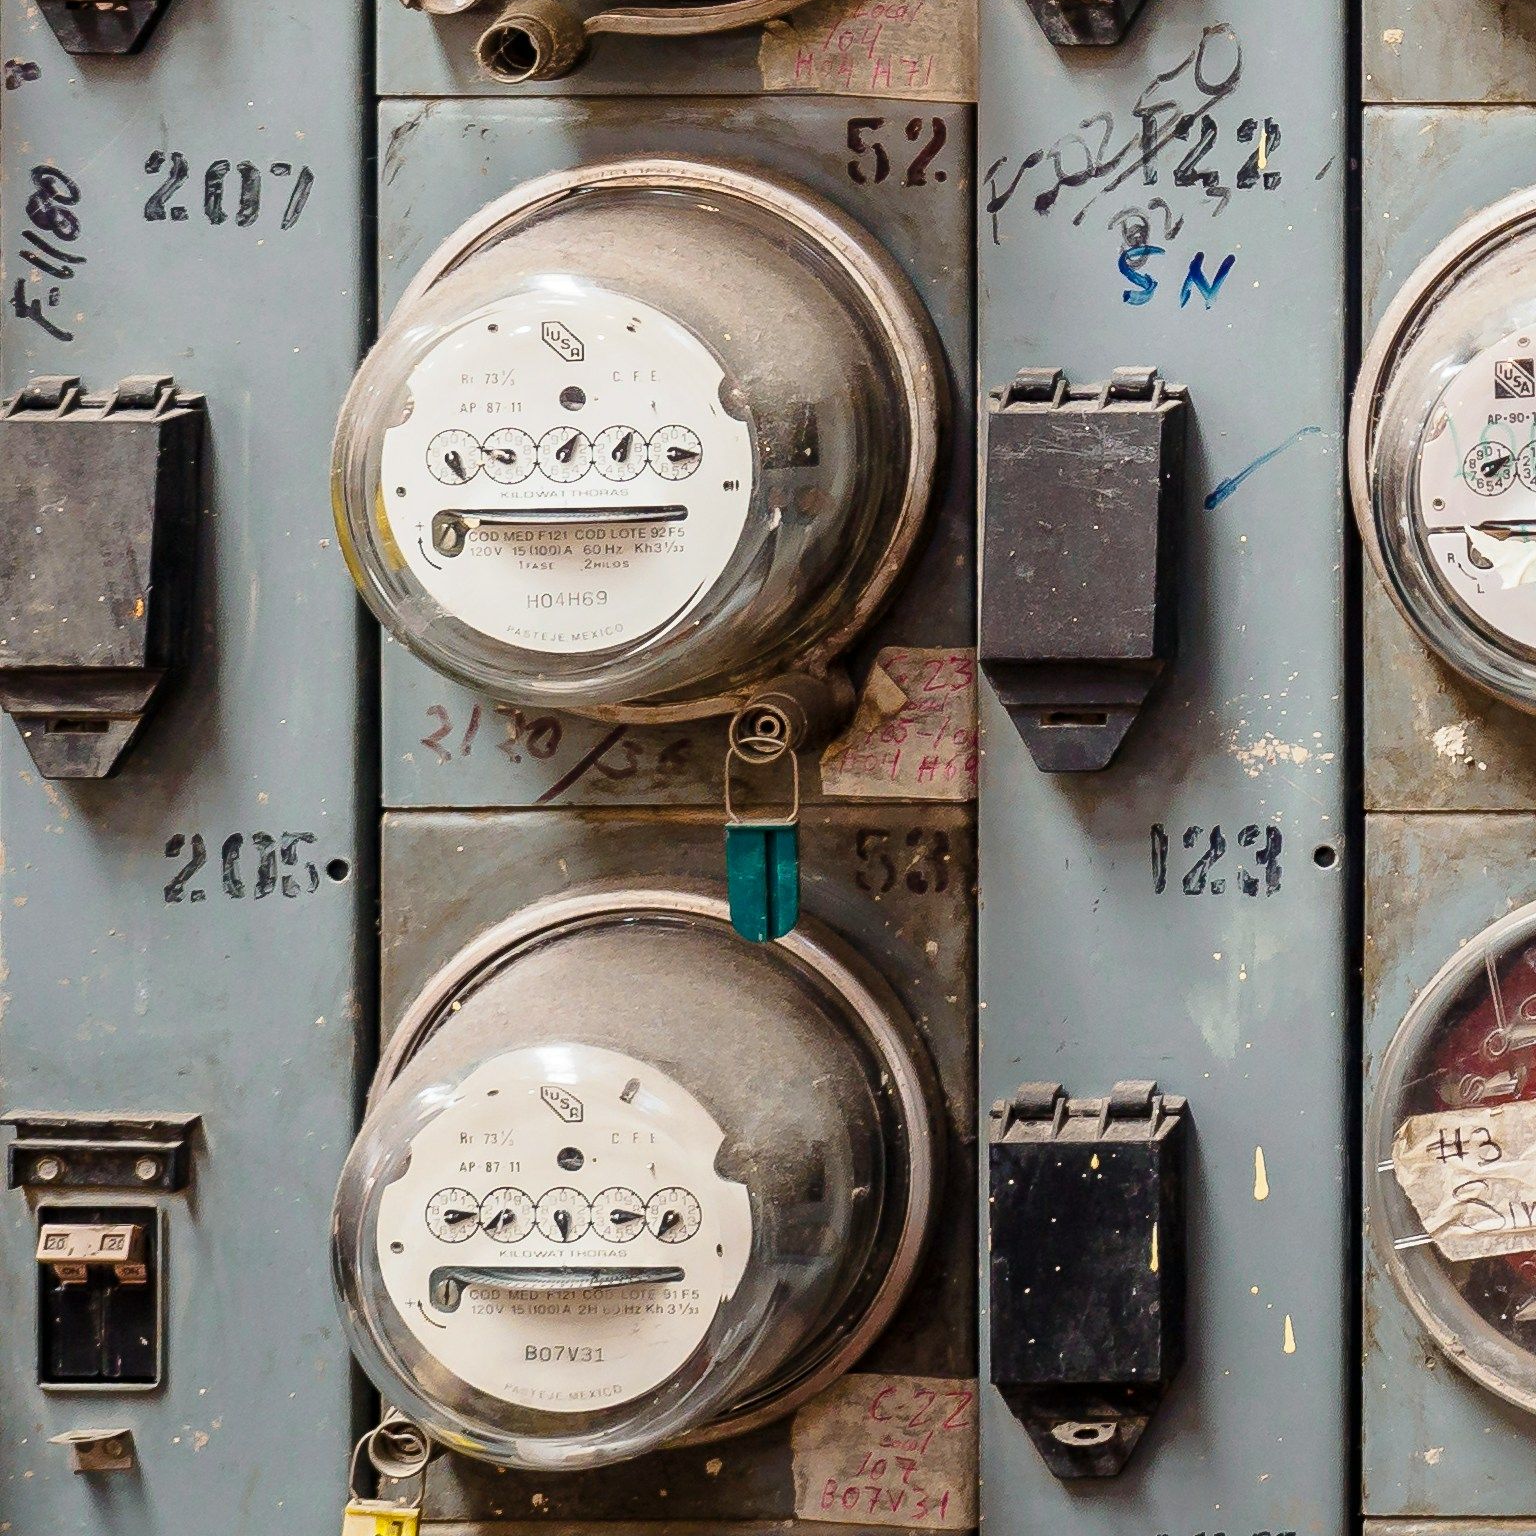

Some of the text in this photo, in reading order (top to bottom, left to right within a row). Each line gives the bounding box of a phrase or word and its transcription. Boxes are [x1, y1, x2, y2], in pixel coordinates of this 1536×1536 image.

[846, 117, 948, 186] 52
[144, 150, 314, 230] 207
[543, 324, 583, 360] IUSA
[1497, 362, 1533, 396] IUSA
[163, 830, 320, 904] 205
[855, 827, 950, 894] 53
[1150, 823, 1282, 897] 123
[525, 1345, 605, 1363] B07V31
